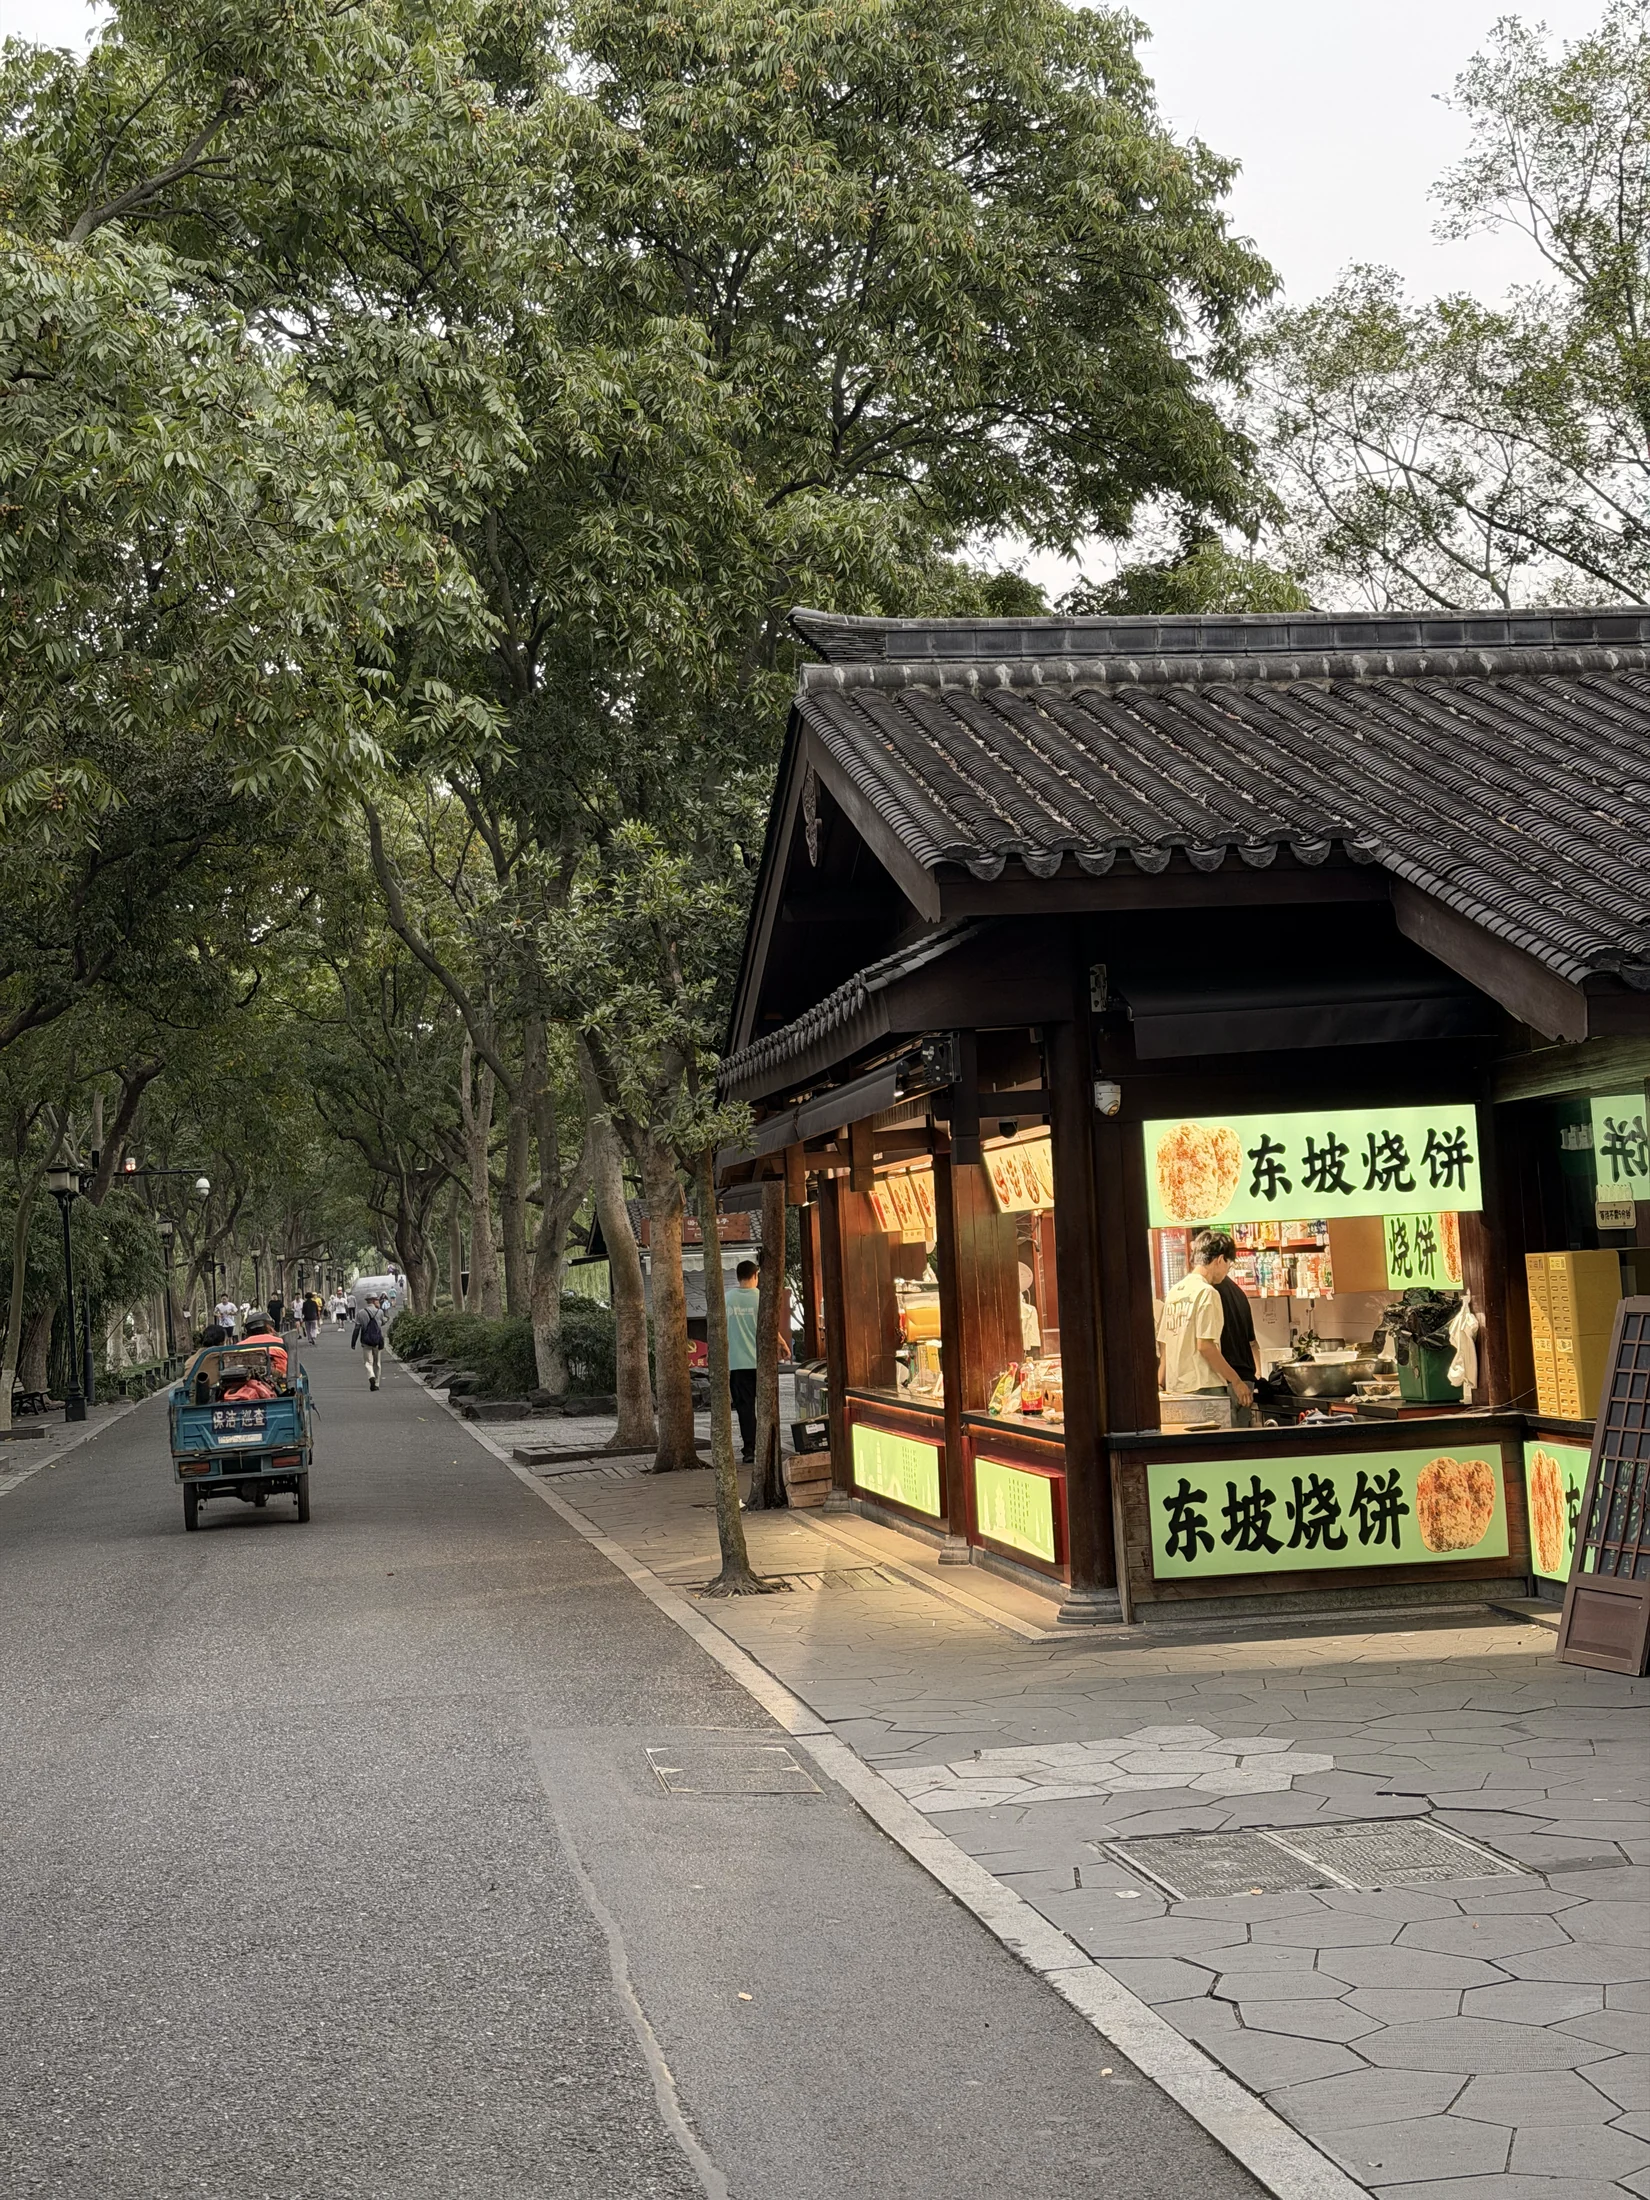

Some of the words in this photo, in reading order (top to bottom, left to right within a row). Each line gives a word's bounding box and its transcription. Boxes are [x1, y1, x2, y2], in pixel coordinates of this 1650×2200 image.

[1247, 1125, 1474, 1202] 东坡烧饼
[1389, 1215, 1437, 1280] 烧饼
[213, 1410, 237, 1429] 保洁
[241, 1408, 265, 1427] 巡查
[1162, 1467, 1411, 1564] 东坡烧饼
